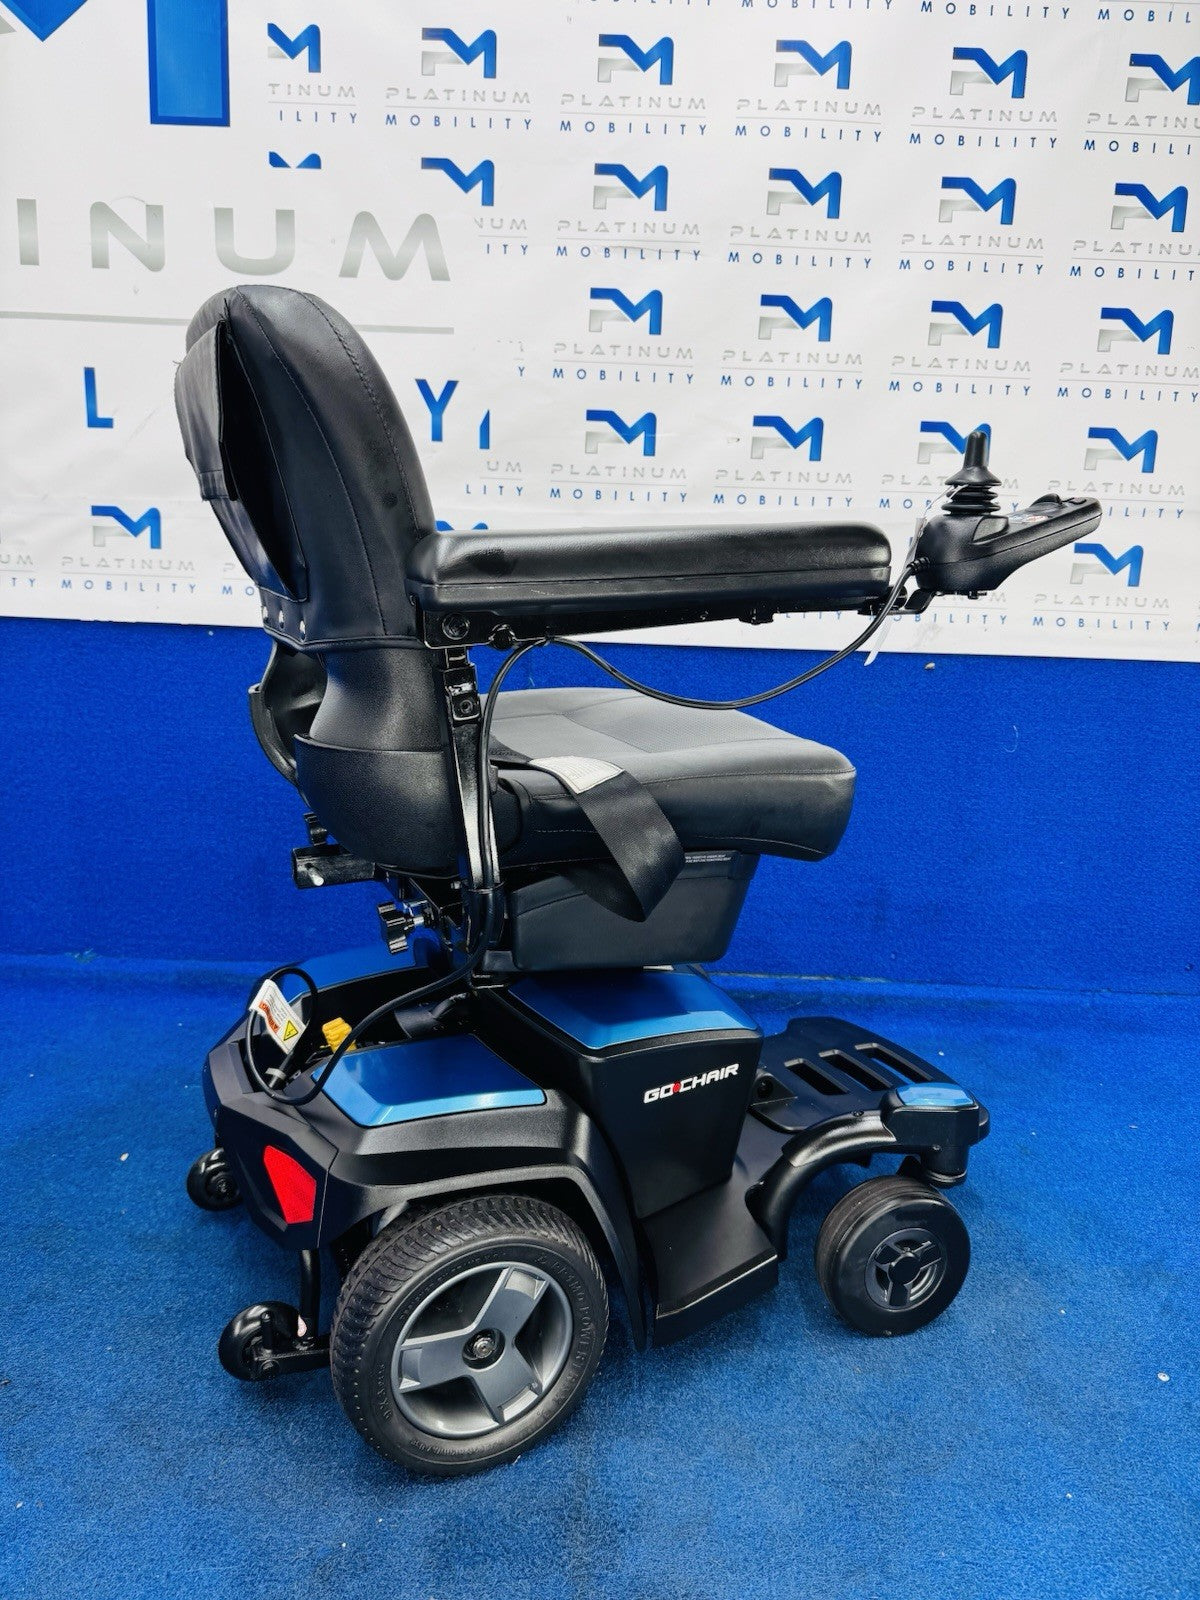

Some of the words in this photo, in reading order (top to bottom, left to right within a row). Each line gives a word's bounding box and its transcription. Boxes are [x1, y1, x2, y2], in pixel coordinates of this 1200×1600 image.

[921, 1, 1070, 19] MOBILITY
[386, 87, 530, 104] PLATINUM
[561, 94, 706, 109] PLATINUM
[737, 99, 881, 116] PLATINUM
[912, 106, 1057, 122] PLATINUM
[386, 114, 531, 130] MOBILITY
[560, 120, 706, 135] MOBILITY
[735, 125, 881, 142] MOBILITY
[909, 133, 1057, 148] MOBILITY
[558, 220, 699, 238] PLATINUM
[730, 225, 871, 243] PLATINUM
[902, 234, 1043, 249] PLATINUM
[1073, 240, 1200, 256] PLATINU
[556, 246, 700, 261] MOBILITY
[728, 252, 871, 268] MOBILITY
[899, 259, 1043, 275] MOBILITY
[554, 343, 693, 359] PLATINUM
[723, 350, 862, 365] PLATINUM
[892, 356, 1031, 372] PLATINUM
[1060, 362, 1199, 378] PLATINUM
[553, 368, 693, 384] MOBILITY
[721, 375, 862, 389] MOBILITY
[889, 381, 1031, 396] MOBILITY
[1057, 387, 1198, 402] MOBILITY
[551, 464, 686, 479] PLATINUM
[715, 470, 852, 484] PLATINUM
[550, 488, 687, 502] MOBILITY
[1047, 480, 1185, 496] PLATINUM
[713, 494, 852, 507] MOBILITY
[62, 556, 194, 571] PLATINUM
[62, 580, 195, 593] MOBILITY
[1034, 594, 1169, 611] PLATINUM
[1033, 617, 1169, 630] MOBILITY
